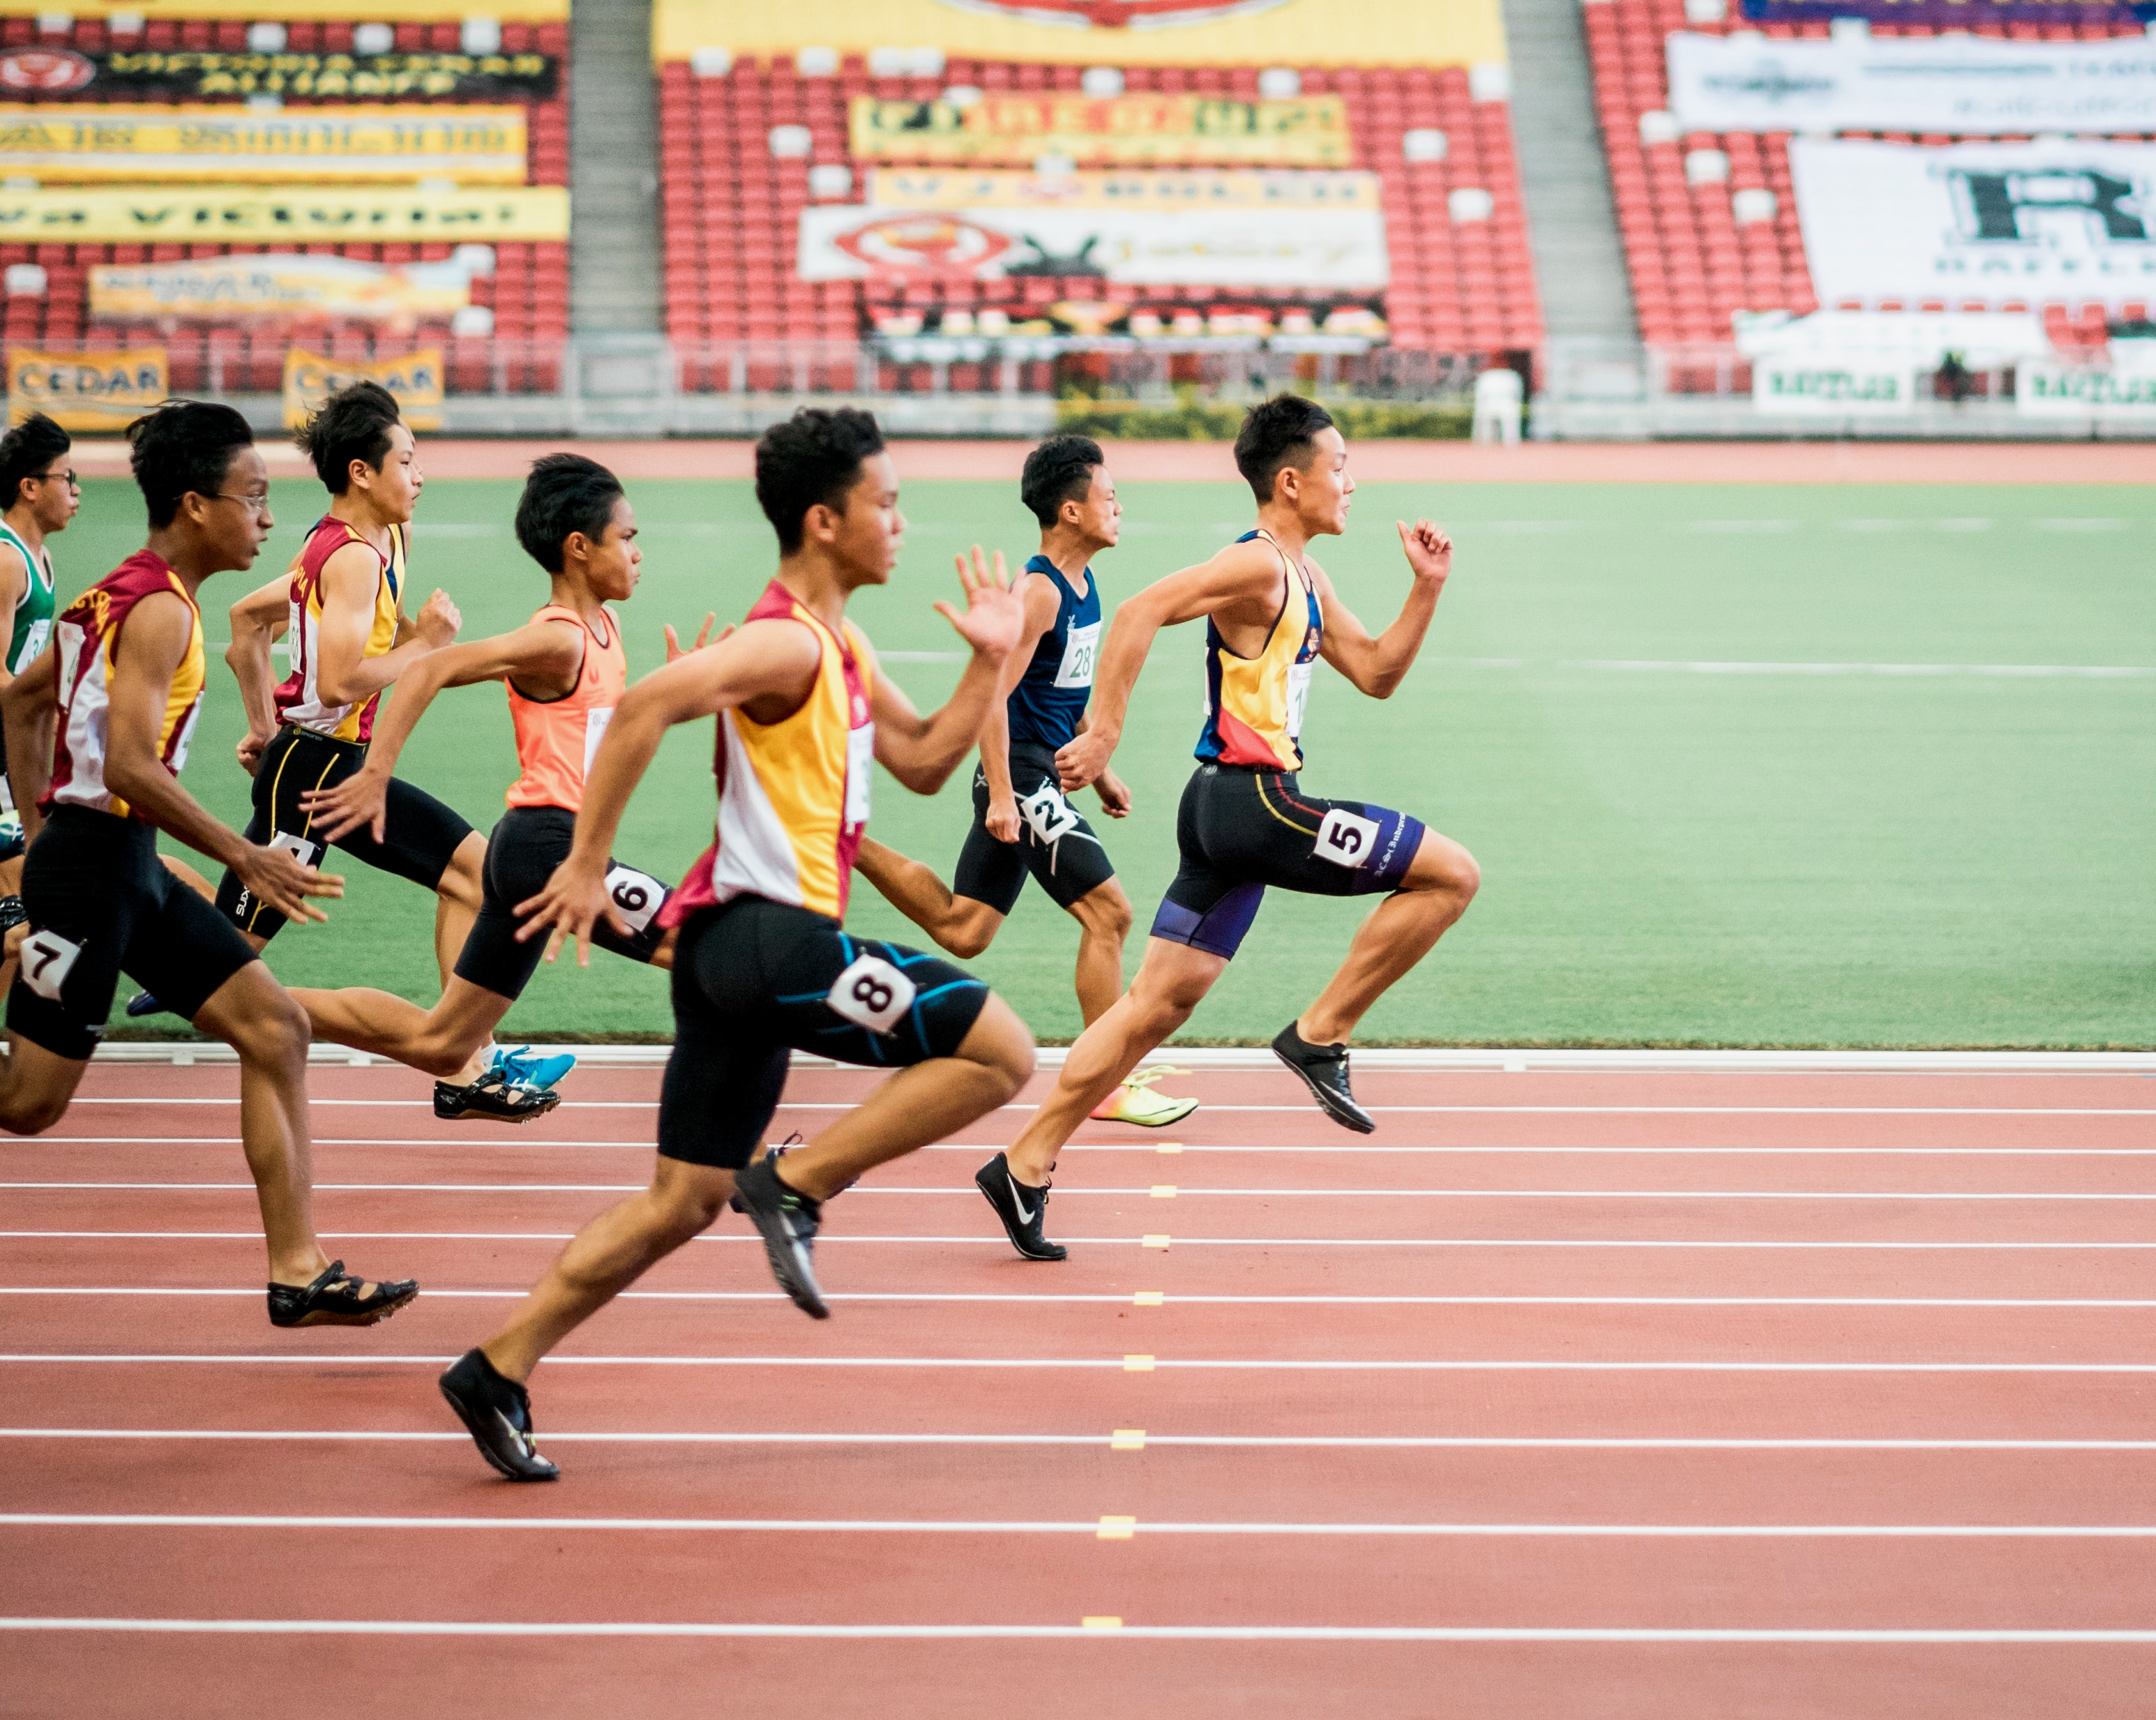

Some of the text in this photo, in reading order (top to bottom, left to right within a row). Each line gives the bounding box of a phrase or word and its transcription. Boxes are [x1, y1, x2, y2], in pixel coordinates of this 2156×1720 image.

[1069, 645, 1091, 678] 28
[1034, 799, 1065, 831] 2
[1328, 821, 1362, 854] 5
[612, 880, 649, 912] 6
[32, 940, 62, 981] 7
[852, 974, 894, 1013] 8
